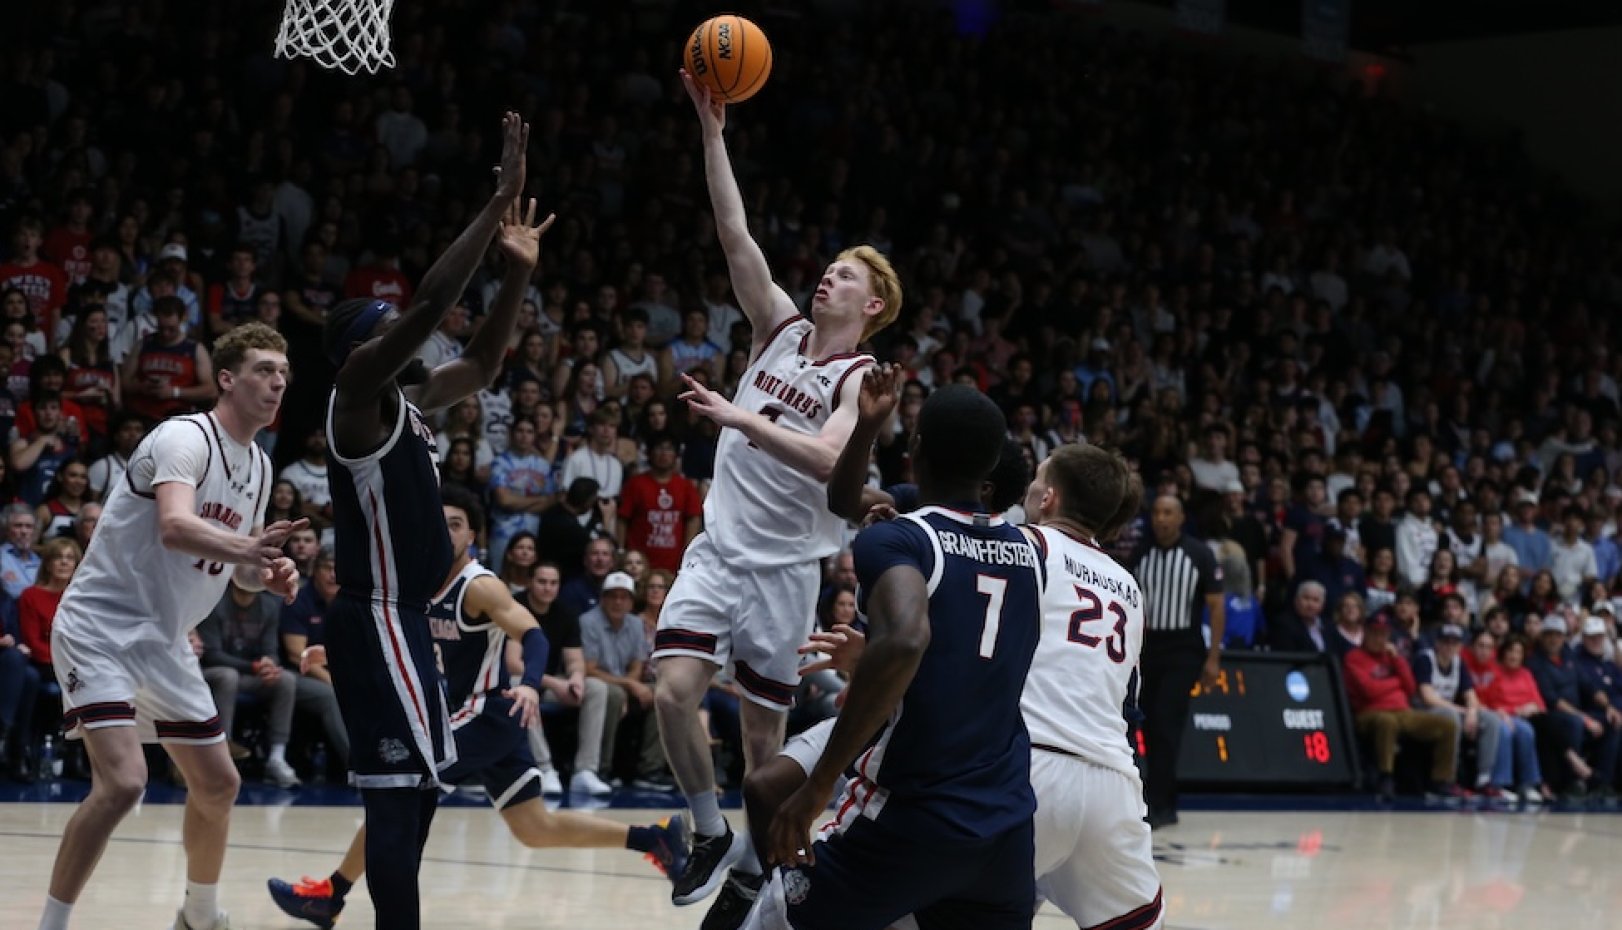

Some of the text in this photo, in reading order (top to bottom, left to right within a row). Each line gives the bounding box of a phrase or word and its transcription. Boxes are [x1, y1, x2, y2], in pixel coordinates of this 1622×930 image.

[718, 23, 732, 60] NCAA
[753, 370, 783, 395] AINT
[937, 530, 1036, 568] GRANT-FOSTER
[1063, 553, 1139, 609] MURAUSKAS
[974, 572, 1009, 661] 7
[1067, 583, 1127, 663] 23
[1282, 708, 1325, 730] GUEST
[1303, 730, 1332, 764] 18
